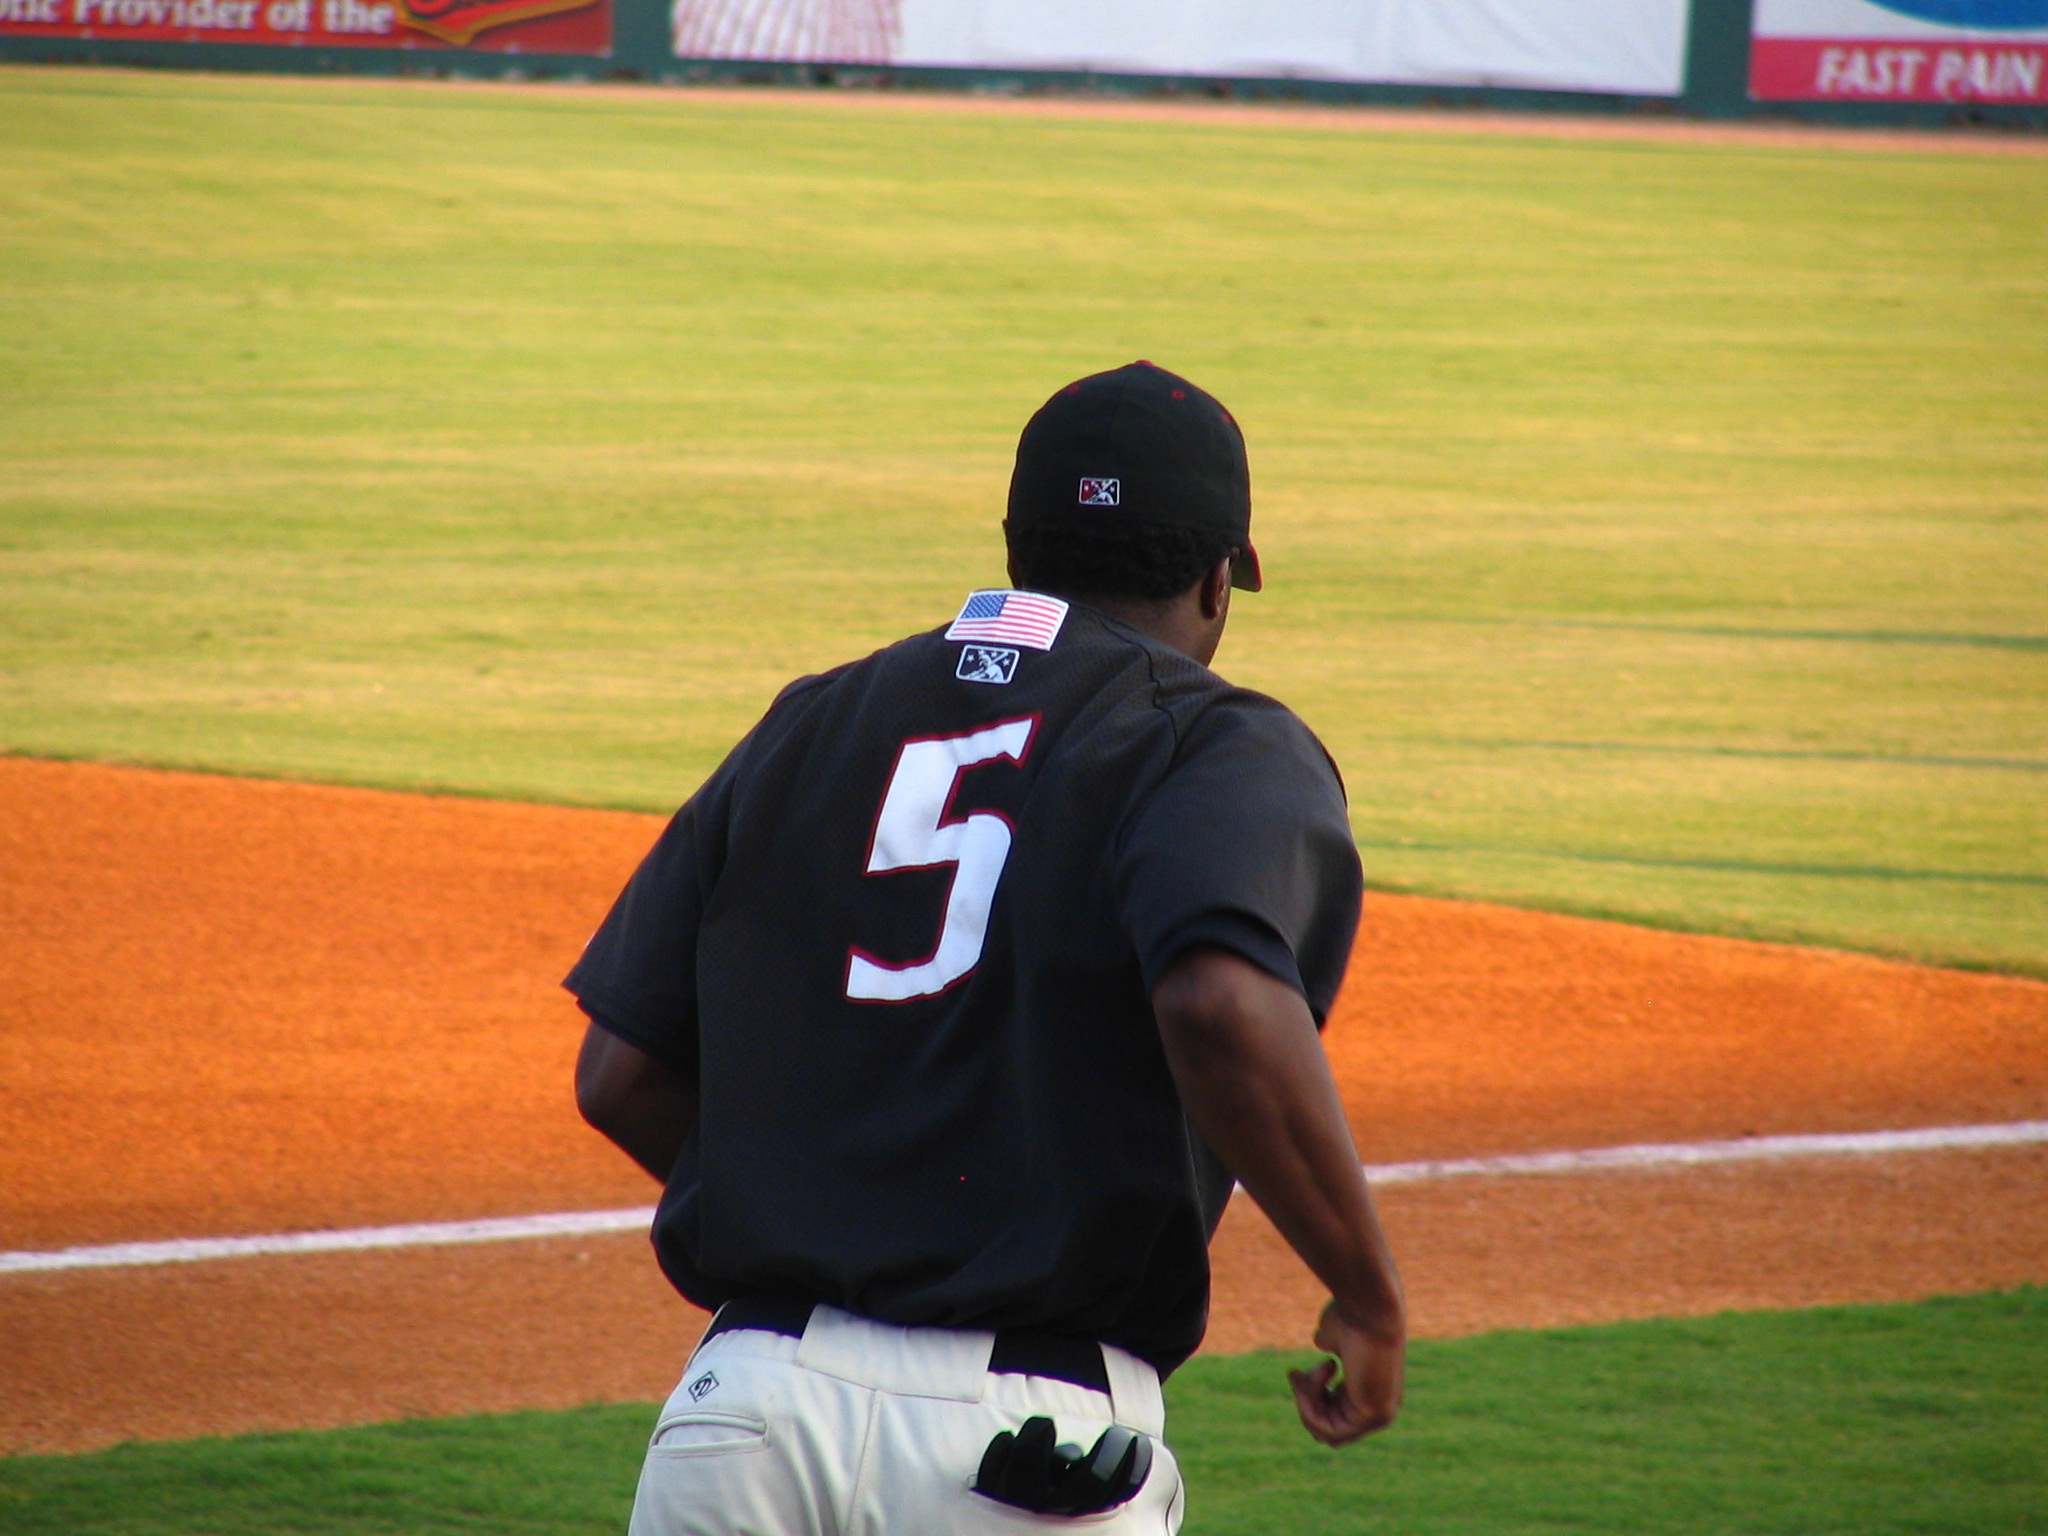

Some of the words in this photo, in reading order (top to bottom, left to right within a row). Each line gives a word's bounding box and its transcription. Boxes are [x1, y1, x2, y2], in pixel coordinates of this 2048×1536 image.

[72, 0, 259, 31] Provider
[265, 0, 314, 33] of
[322, 0, 397, 35] the
[1814, 47, 1929, 96] FAST
[1931, 49, 2044, 98] PAIN
[846, 713, 1041, 1005] 5
